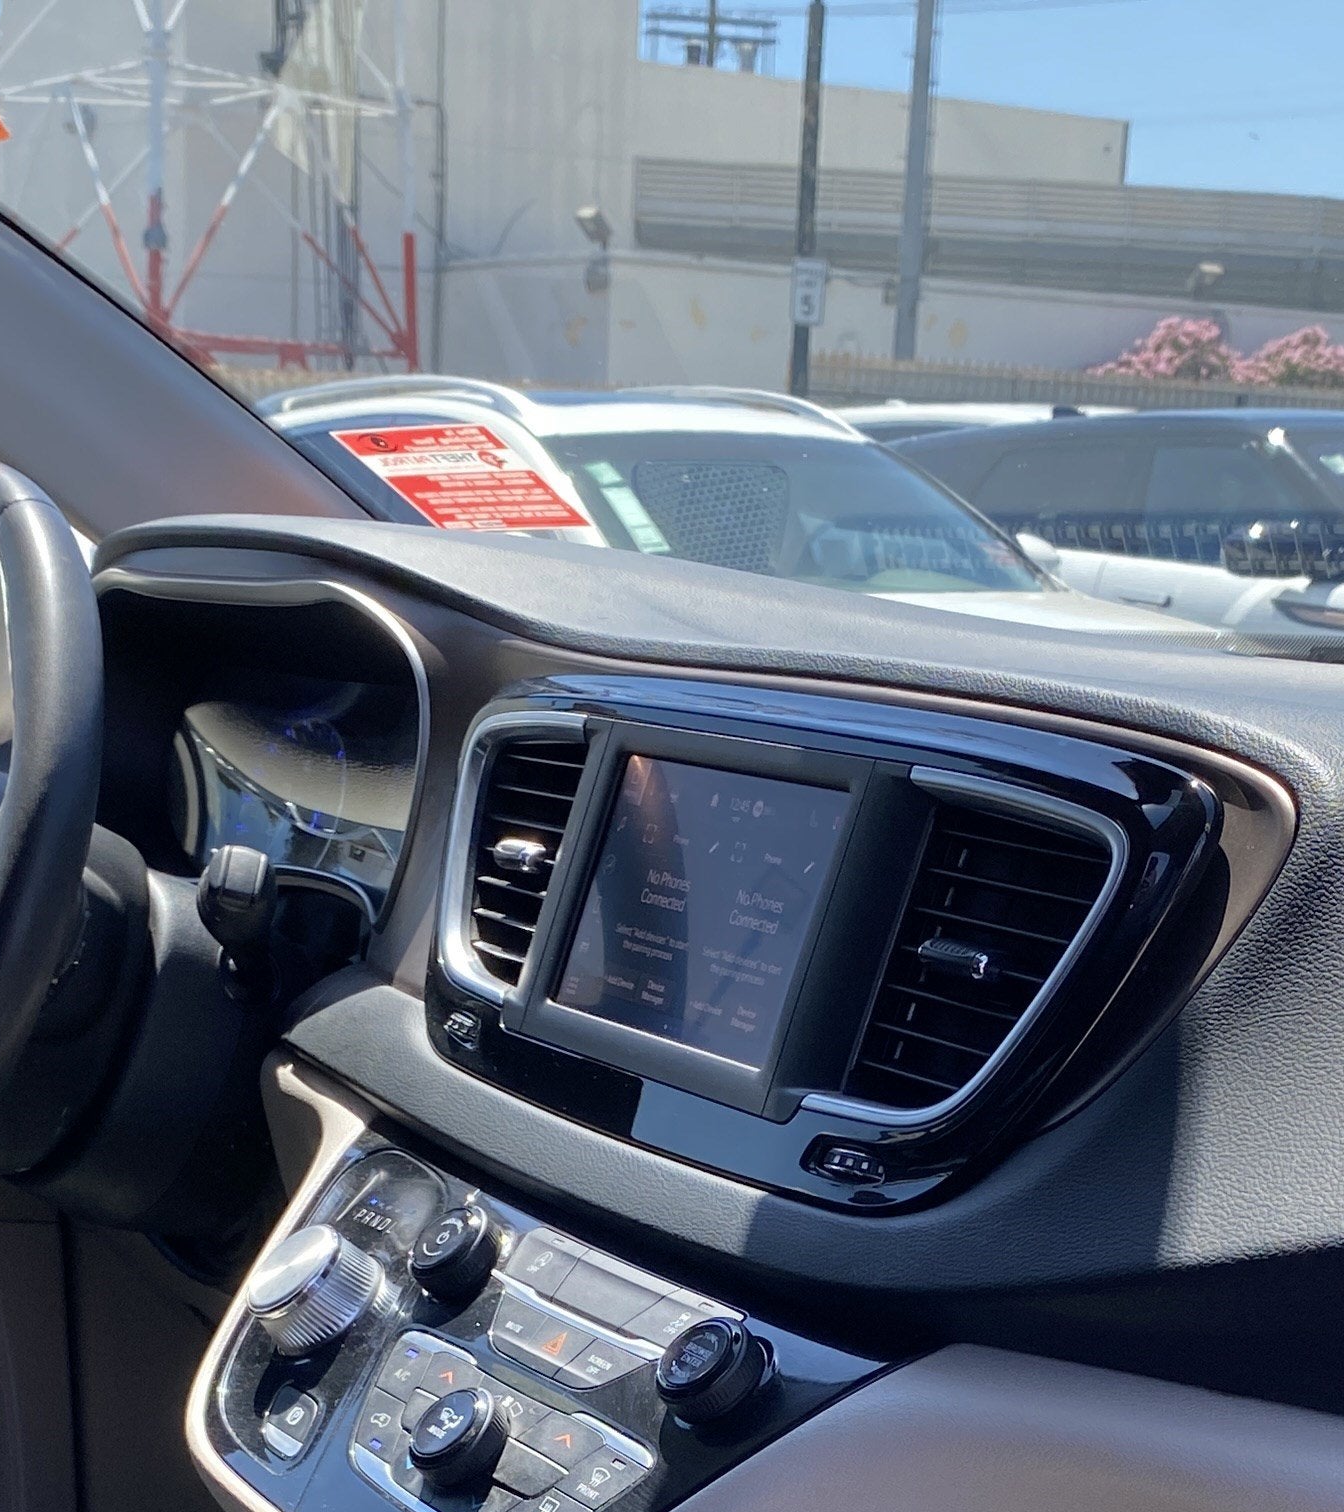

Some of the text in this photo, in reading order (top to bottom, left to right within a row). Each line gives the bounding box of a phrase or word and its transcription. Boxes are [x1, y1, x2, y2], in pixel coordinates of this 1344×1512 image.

[800, 294, 815, 316] 5
[646, 868, 692, 893] No Phones
[640, 887, 687, 913] Connected
[736, 888, 785, 915] No Phones
[728, 909, 779, 935] Connected
[587, 1353, 613, 1371] SCREEN
[393, 1367, 412, 1382] A/C
[575, 1482, 600, 1501] FRONT
